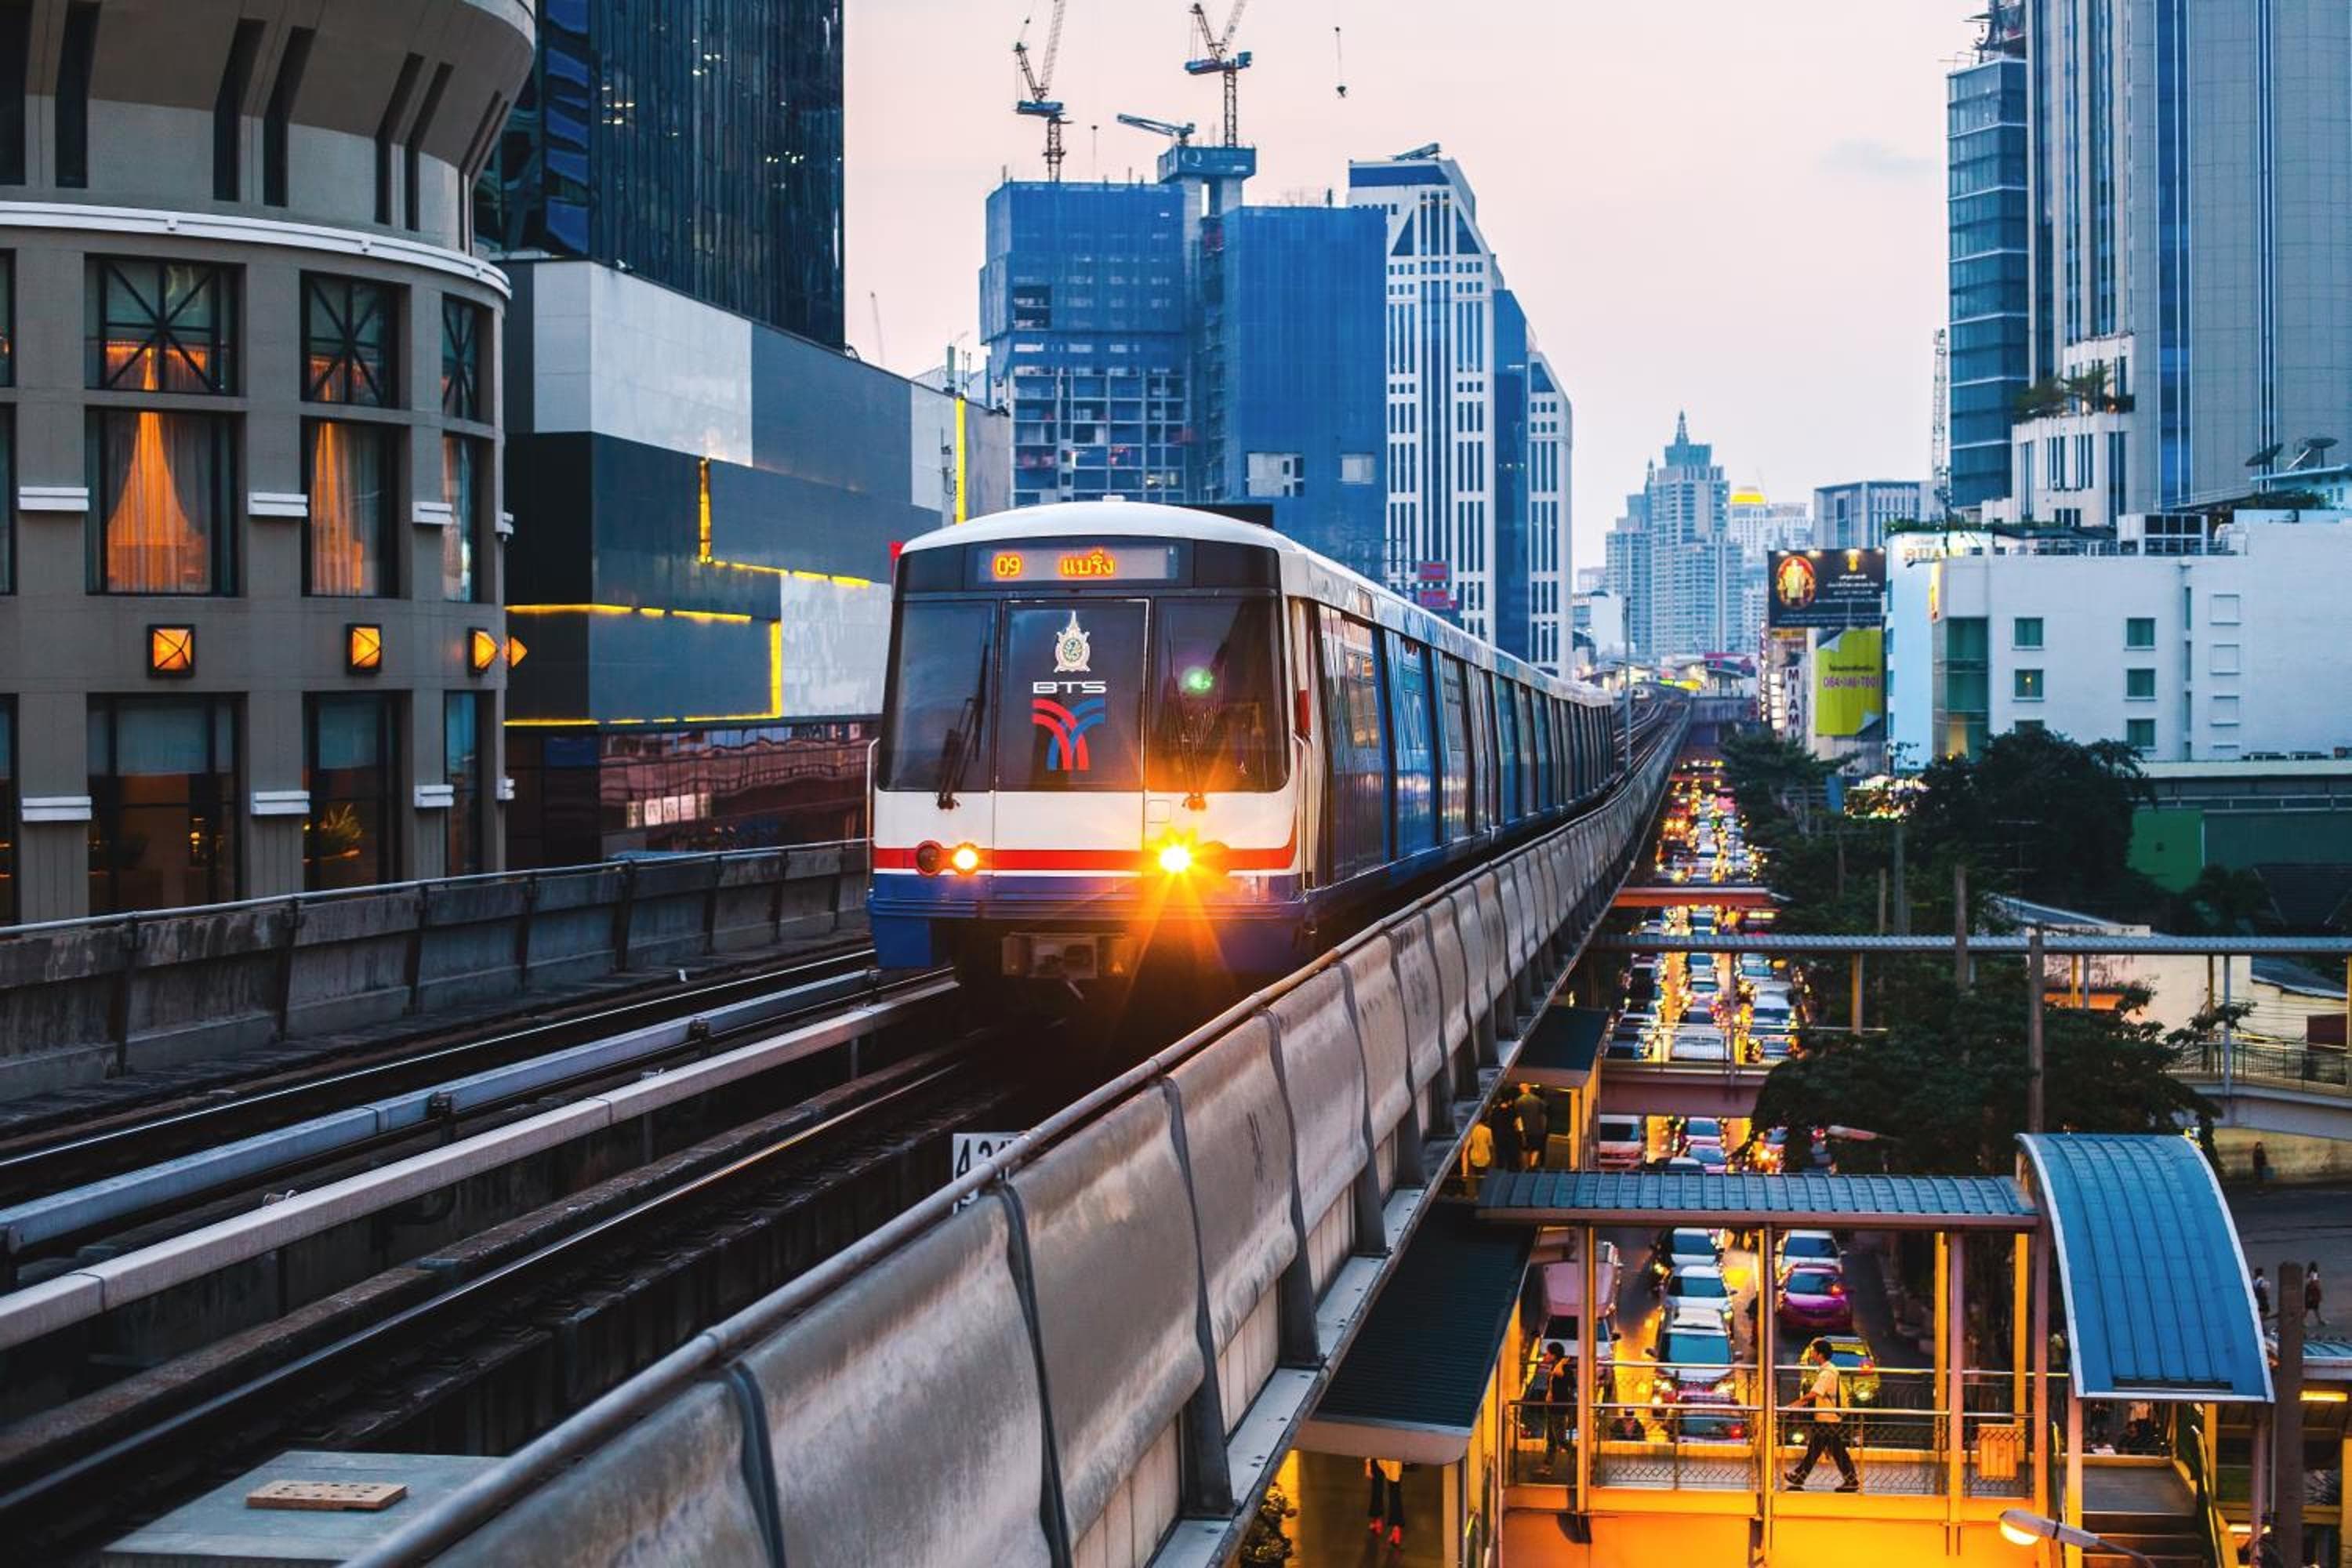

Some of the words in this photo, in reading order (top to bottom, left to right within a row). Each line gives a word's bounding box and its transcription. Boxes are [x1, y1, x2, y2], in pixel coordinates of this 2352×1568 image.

[995, 556, 1022, 576] 09
[1062, 548, 1116, 576] แบริ่ง
[1033, 681, 1107, 694] BTS
[1788, 668, 1800, 739] MIAMI
